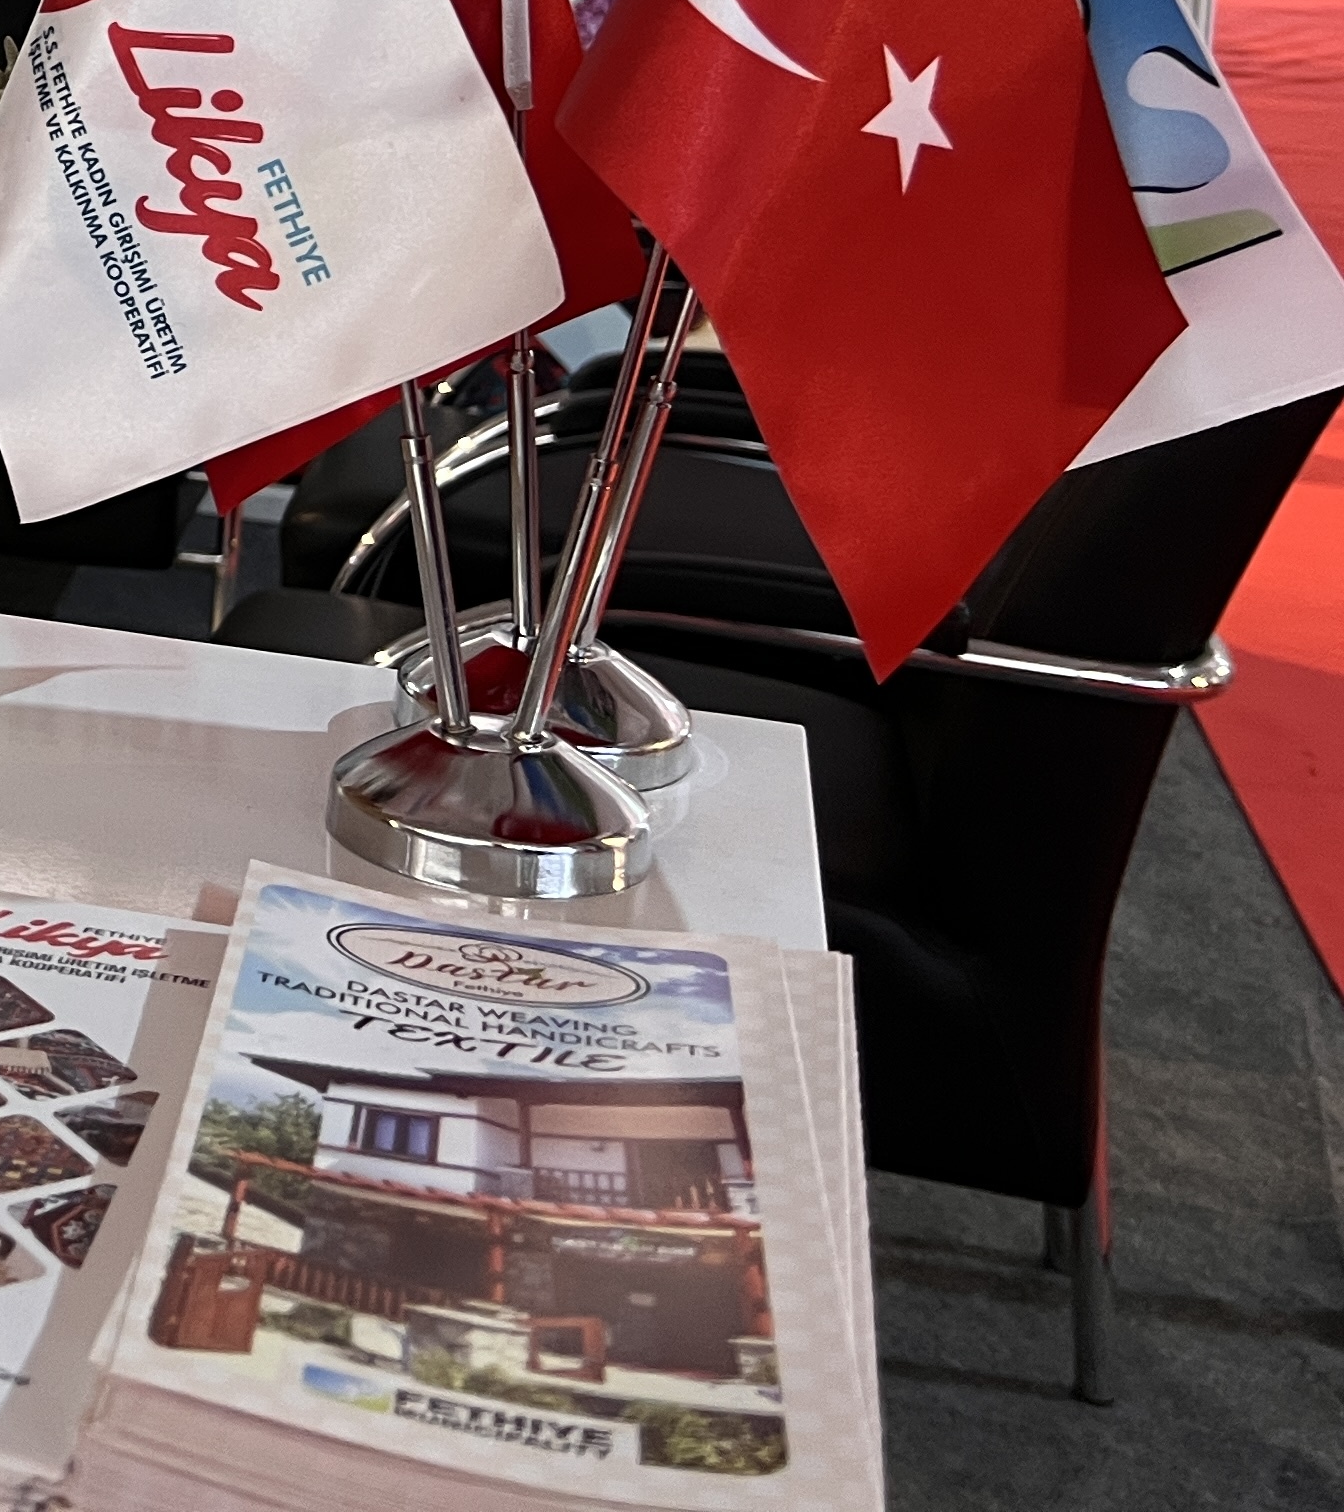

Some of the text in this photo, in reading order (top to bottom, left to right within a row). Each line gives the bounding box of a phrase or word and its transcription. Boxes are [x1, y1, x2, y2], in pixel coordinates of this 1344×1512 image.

[28, 35, 169, 379] İŞLETME VE KALKINMA KOOPERATİFİ
[43, 25, 187, 374] S.S. FETHİYE KADIN GİRİŞİMİ ÜRETİM
[108, 21, 280, 311] Likya
[257, 970, 721, 1058] TRADITIONAL HANDICRAFTS
[337, 1009, 628, 1072] TEXTILE
[346, 979, 639, 1036] DASTAR WEAVING
